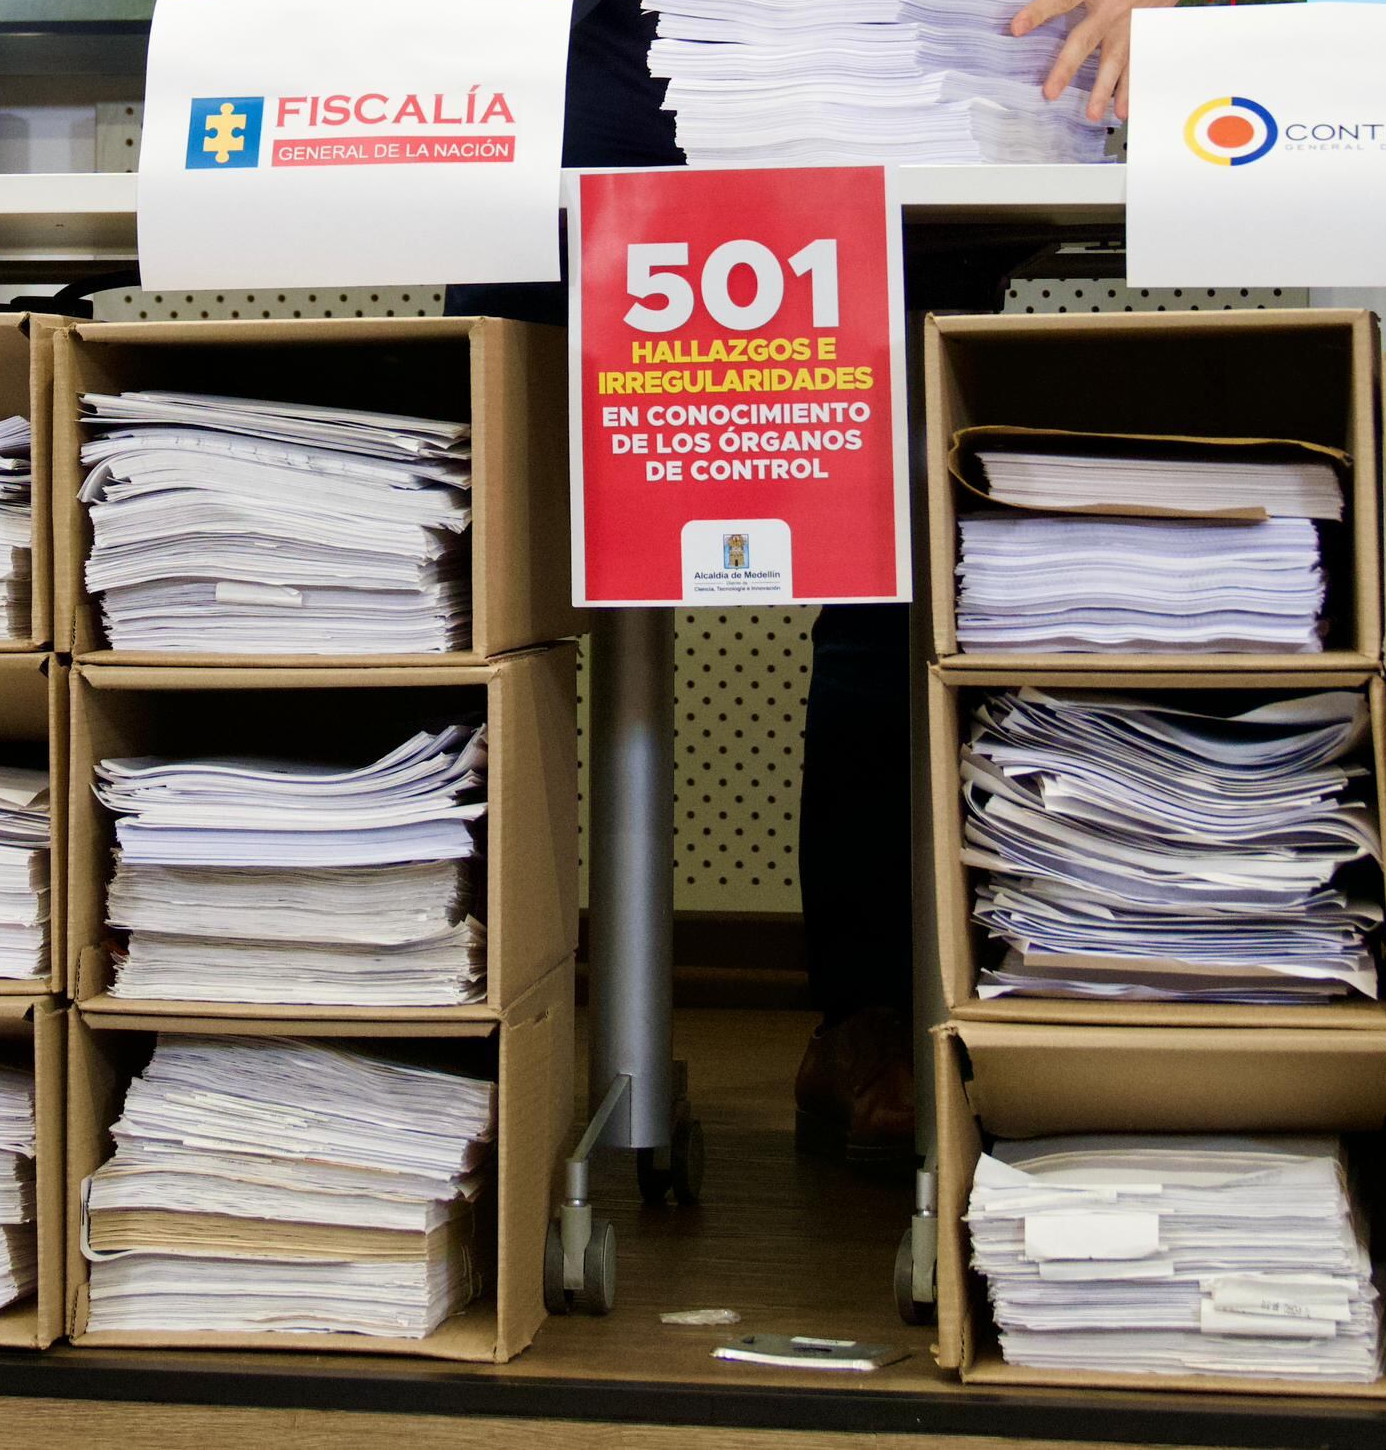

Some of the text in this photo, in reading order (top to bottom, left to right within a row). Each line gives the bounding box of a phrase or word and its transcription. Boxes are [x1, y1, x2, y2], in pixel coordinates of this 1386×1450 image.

[276, 84, 515, 127] FISCALÍA
[278, 139, 509, 161] GENERAL DE LA NACIÓN
[1285, 143, 1364, 151] GENERAL
[623, 238, 839, 333] 501
[632, 337, 837, 364] HALLAZGOS E
[598, 367, 873, 395] IRREGULARIDADES
[602, 402, 871, 428] EN CONOCIMIENTO
[612, 426, 862, 454] DE LOS ÓRGANOS
[646, 458, 829, 481] DE CONTROL
